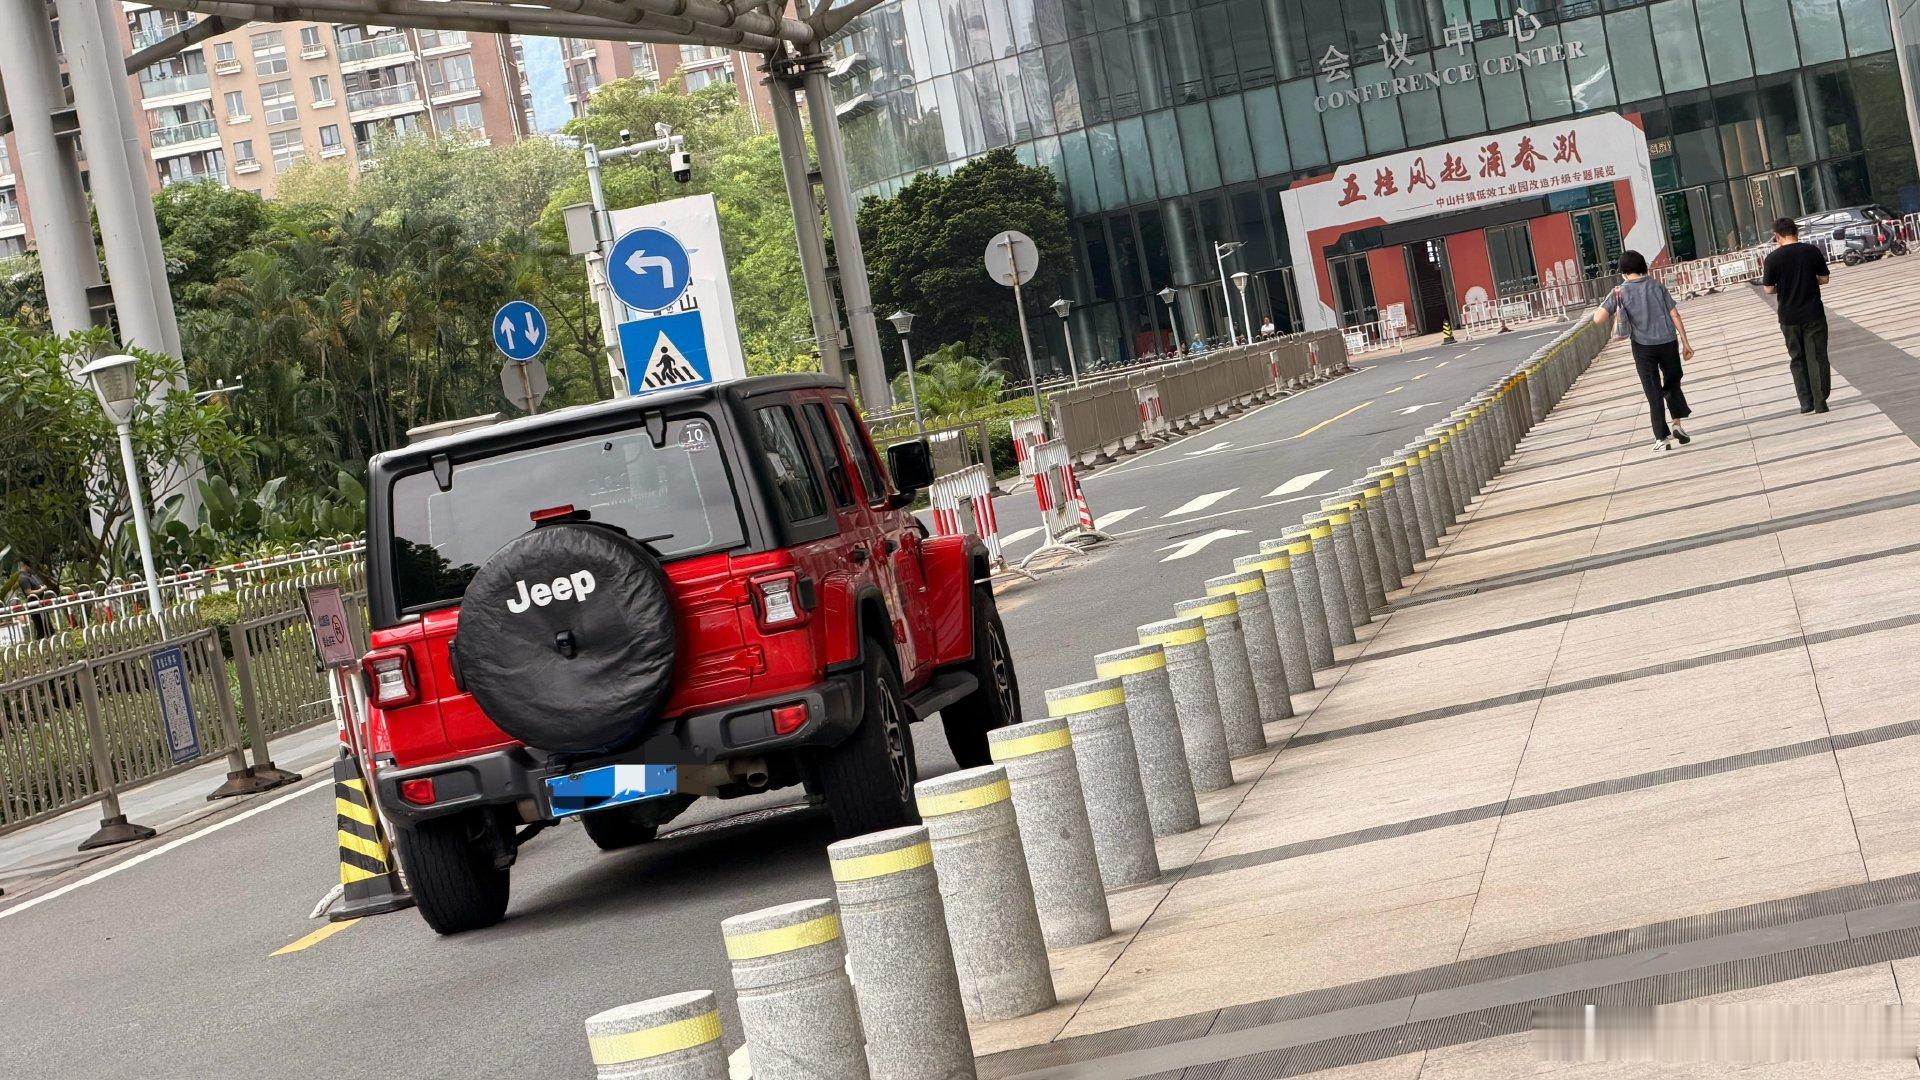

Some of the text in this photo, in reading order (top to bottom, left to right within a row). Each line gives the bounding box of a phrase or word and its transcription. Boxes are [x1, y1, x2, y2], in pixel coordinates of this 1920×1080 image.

[1313, 40, 1587, 113] CONFERENCE CENTER
[1319, 8, 1542, 83] 会议中心
[1338, 130, 1582, 207] 五桂风起涌春潮
[686, 429, 703, 443] 10
[506, 569, 597, 614] Jeep
